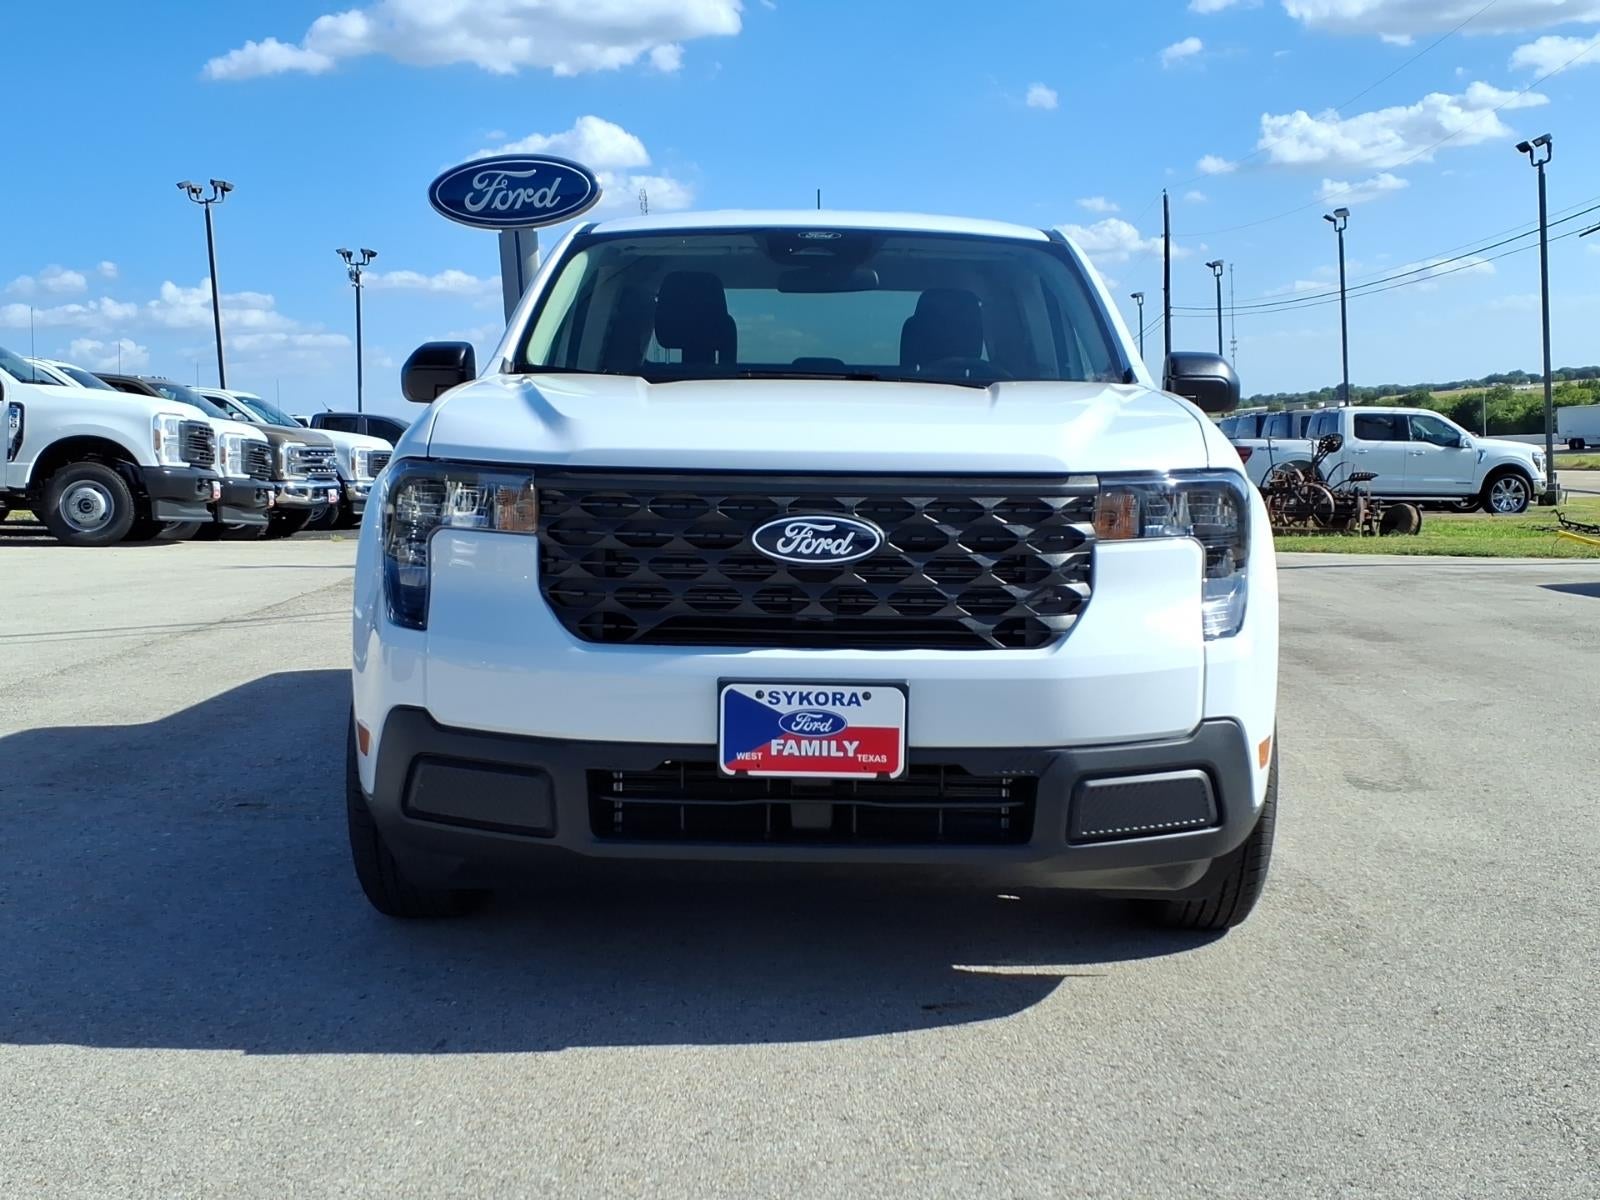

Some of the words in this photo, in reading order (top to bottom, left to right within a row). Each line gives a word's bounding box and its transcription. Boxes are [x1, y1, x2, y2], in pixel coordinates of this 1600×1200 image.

[464, 169, 562, 212] Ford
[777, 522, 855, 555] Ford
[768, 690, 861, 707] SYKORA
[791, 712, 833, 732] Ford
[770, 738, 860, 757] FAMILY
[736, 752, 763, 761] WEST
[856, 754, 887, 763] TEXAS
